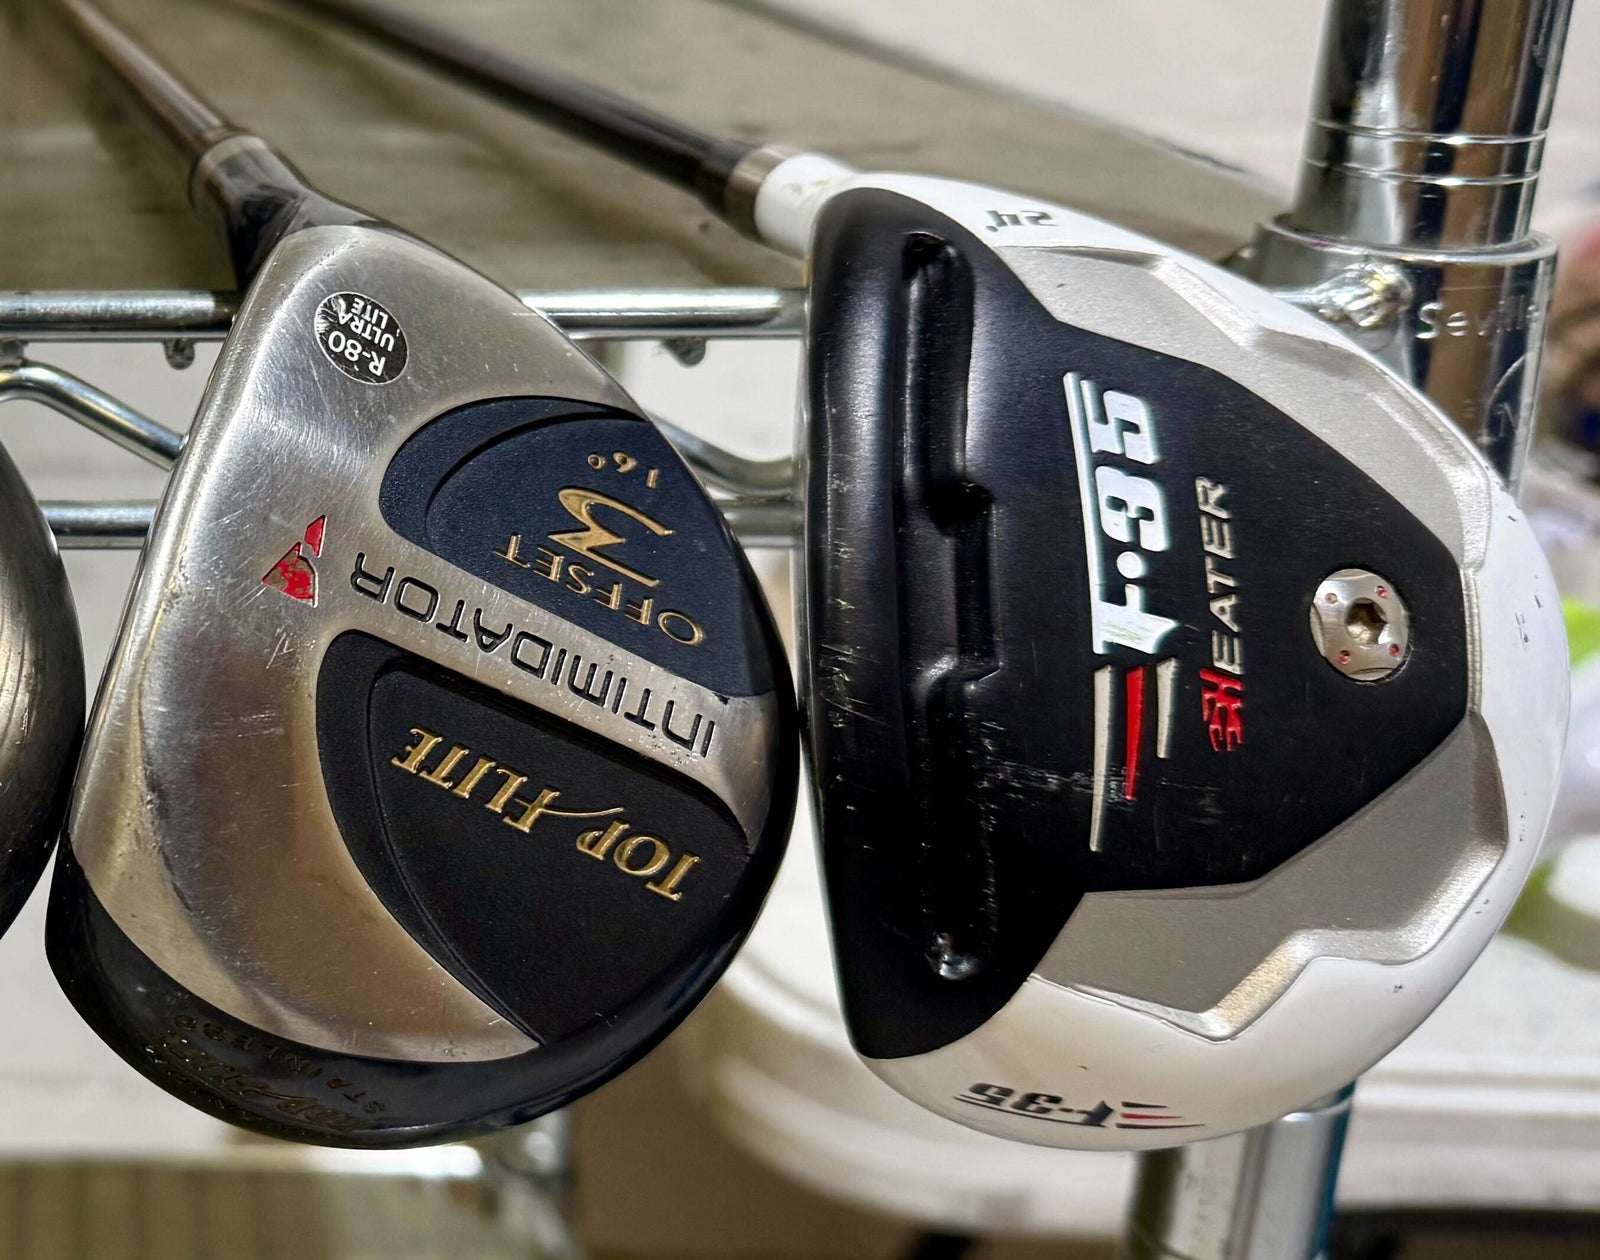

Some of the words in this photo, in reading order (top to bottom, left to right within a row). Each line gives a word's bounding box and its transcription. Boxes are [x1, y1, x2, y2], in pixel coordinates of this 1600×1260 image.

[328, 330, 386, 377] R-80
[338, 308, 396, 352] ULTRA
[350, 297, 389, 330] LITE
[586, 450, 660, 489] 16°
[546, 484, 676, 588] 3
[492, 533, 705, 647] OFFSET
[349, 551, 716, 759] INTIMIDATOR
[390, 726, 623, 835] FLITE
[575, 818, 702, 902] TOP
